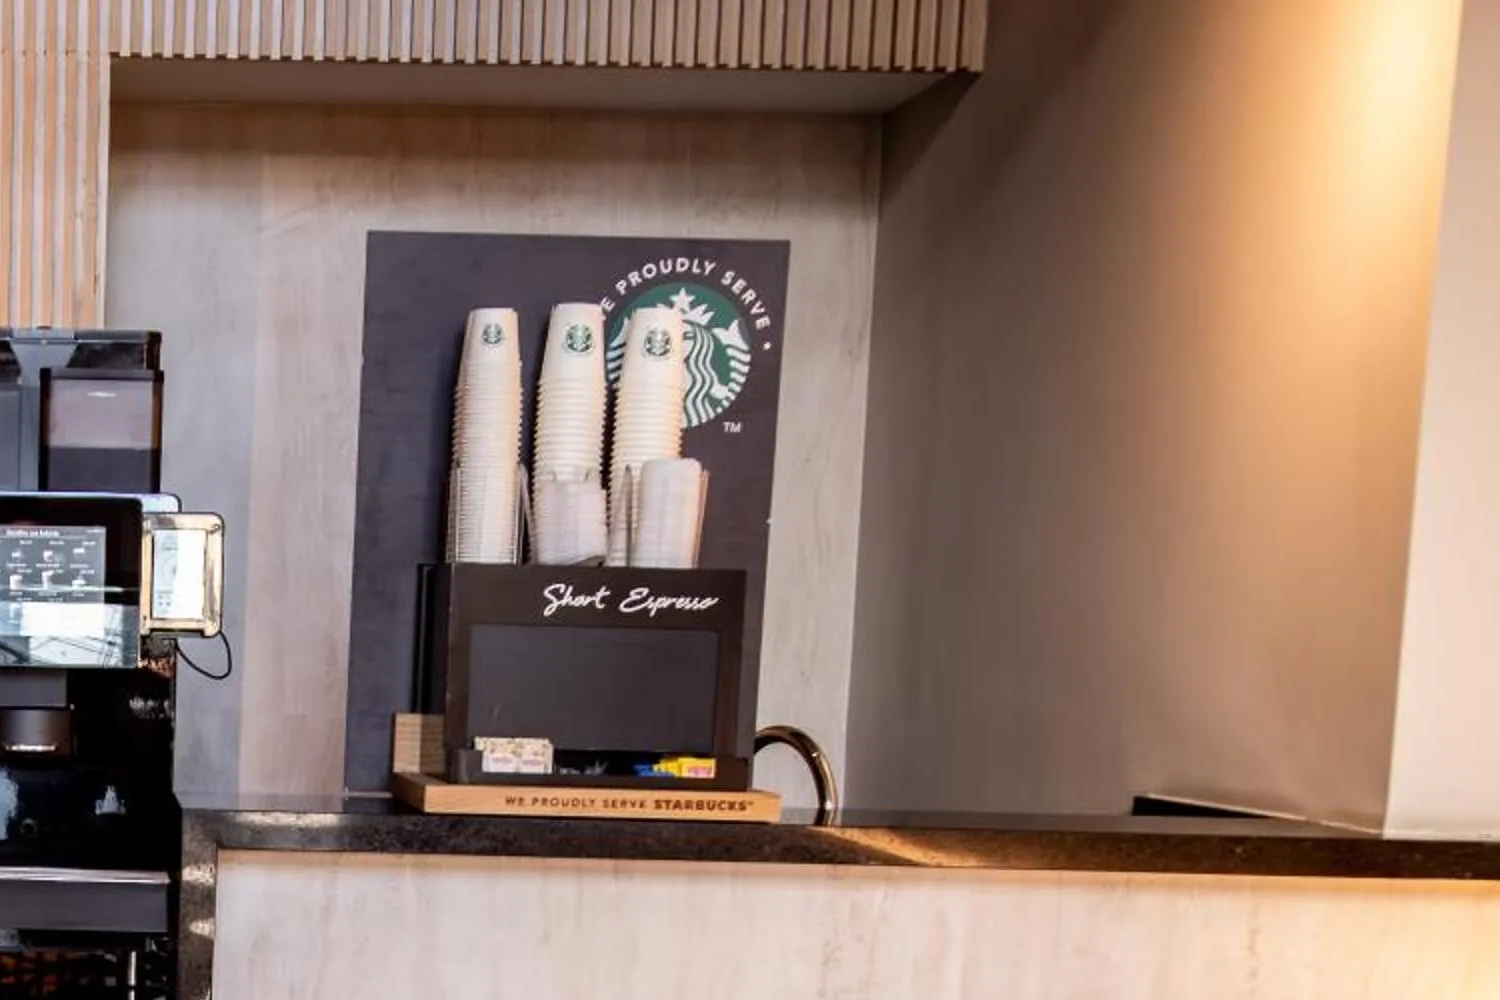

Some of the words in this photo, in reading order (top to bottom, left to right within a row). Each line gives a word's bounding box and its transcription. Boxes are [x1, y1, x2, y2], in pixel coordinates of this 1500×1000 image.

[615, 257, 717, 295] PROUDLY
[721, 271, 771, 330] SERVE
[543, 583, 611, 617] Short
[618, 587, 720, 618] Espresso
[505, 796, 525, 807] WE
[531, 796, 596, 808] PROUDLY
[602, 799, 645, 809] SERVE
[654, 798, 748, 811] STARBUCKS
